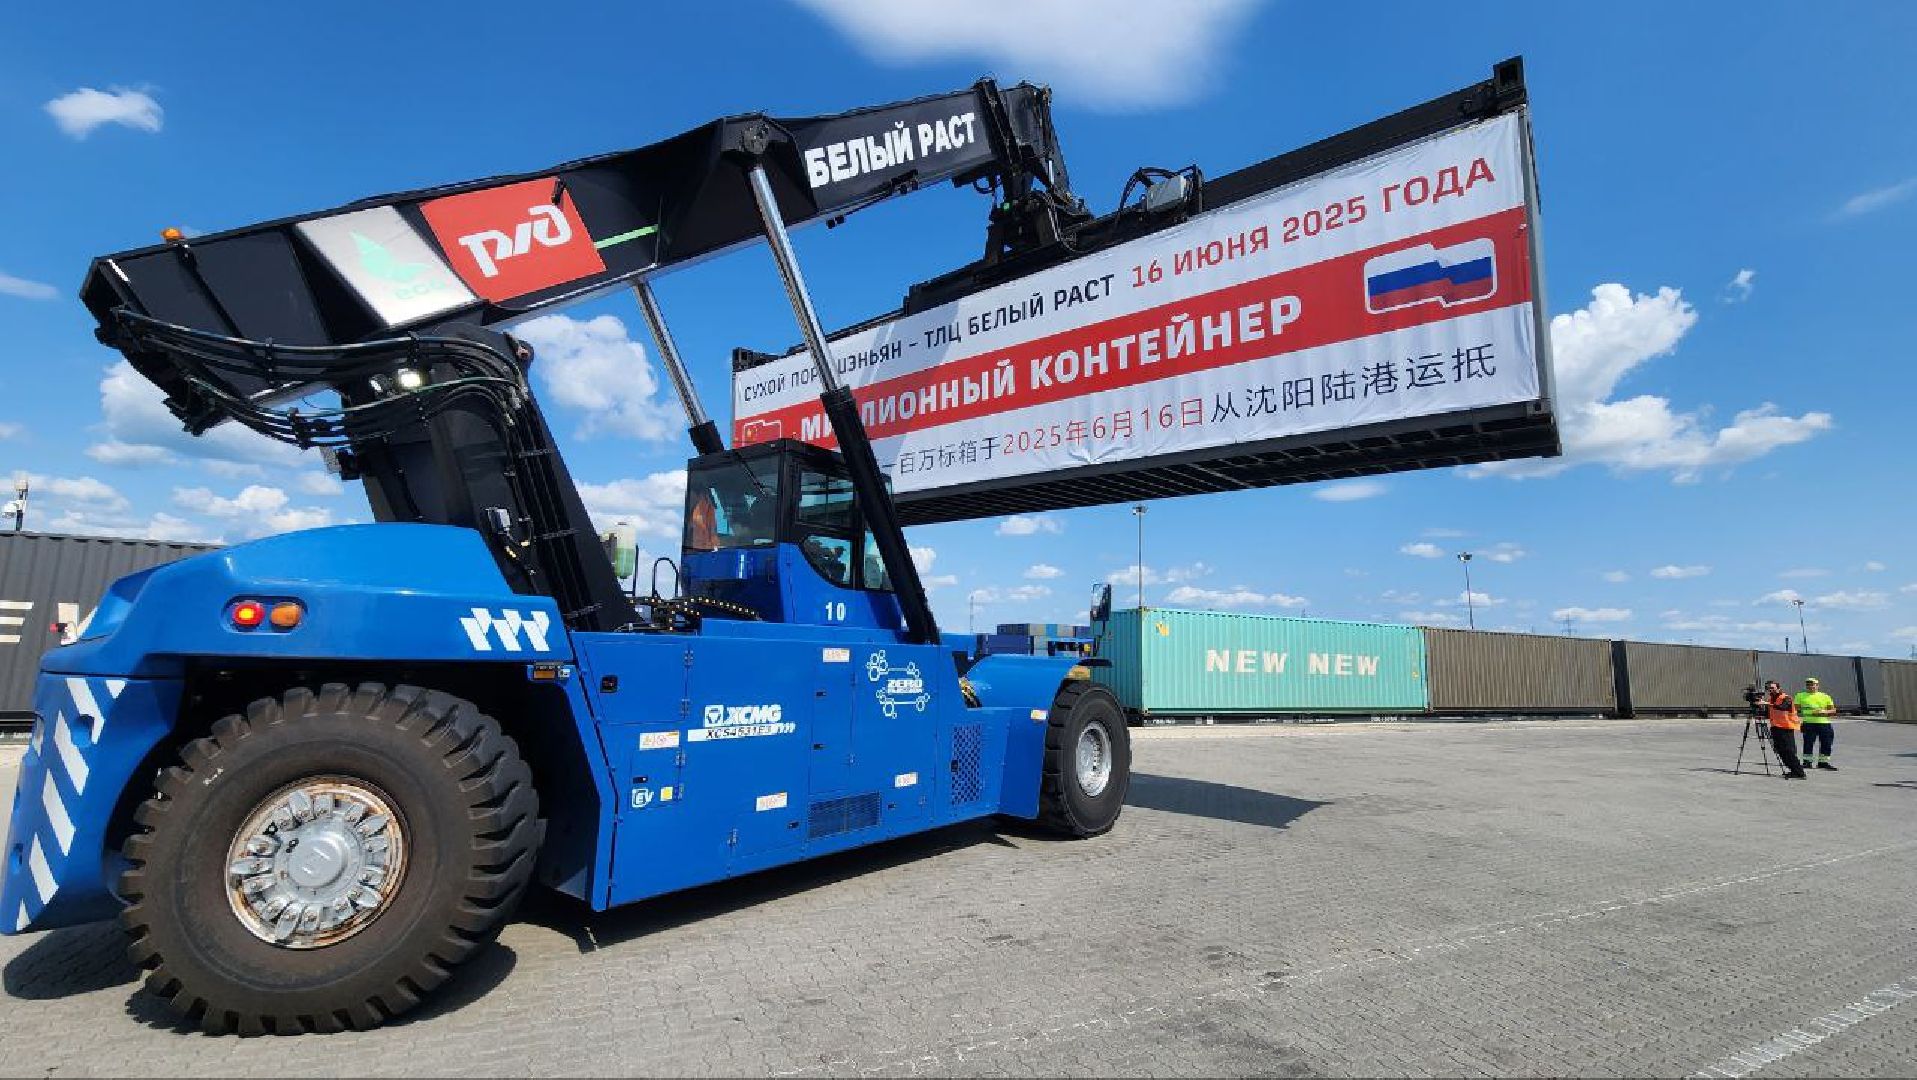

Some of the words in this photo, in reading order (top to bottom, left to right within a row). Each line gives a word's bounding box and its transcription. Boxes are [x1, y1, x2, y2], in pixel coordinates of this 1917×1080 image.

[805, 121, 914, 188] БЕЛЫЙ
[918, 112, 975, 158] РАСТ
[744, 373, 785, 402] СУХОЙ
[791, 366, 819, 387] ПОР
[924, 321, 962, 350] ТЛЦ
[968, 291, 1044, 336] БЕЛЫЙ
[1054, 274, 1115, 311] РАСТ
[1132, 259, 1163, 288] 16
[1174, 225, 1270, 275] ИЮНЯ
[1282, 195, 1367, 243] 2025
[1381, 157, 1495, 213] ГОДА
[801, 357, 1016, 442] МИЛИОННЫЙ
[1030, 295, 1302, 390] КОНТЕЙНЕР
[825, 601, 847, 621] 10
[1206, 649, 1288, 674] NEW
[1308, 652, 1381, 676] NEW
[723, 704, 782, 725] XCMG
